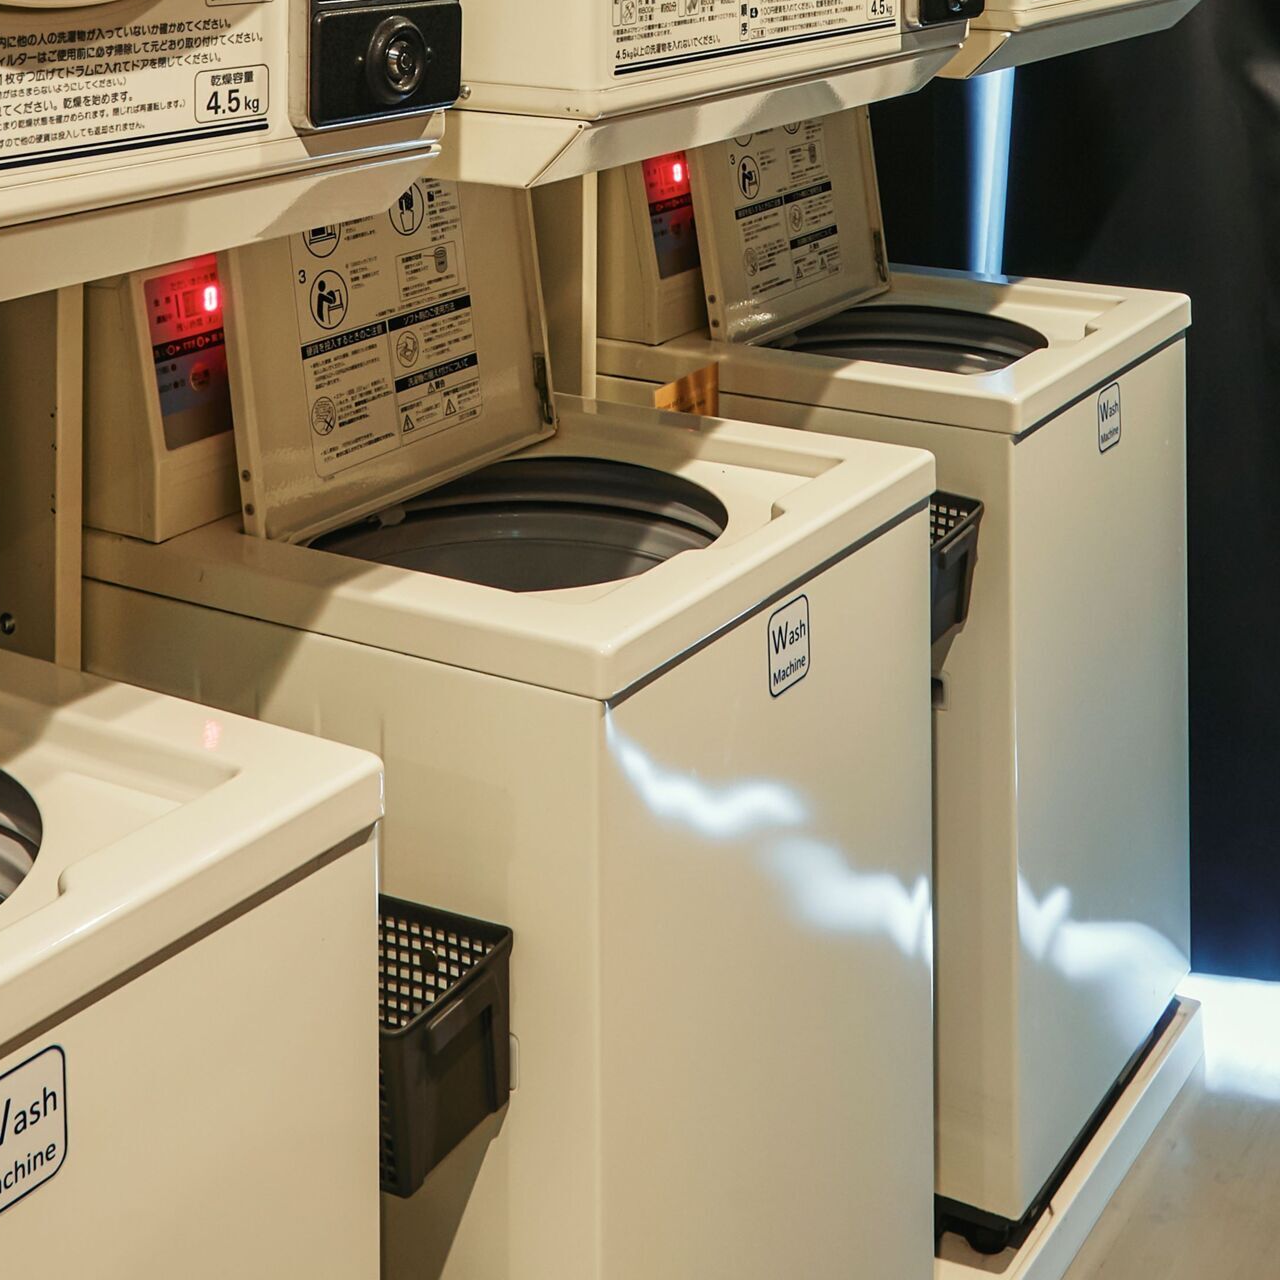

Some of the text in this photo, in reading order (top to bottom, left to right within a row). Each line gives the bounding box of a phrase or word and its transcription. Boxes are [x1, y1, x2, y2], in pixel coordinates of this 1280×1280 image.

[871, 0, 886, 16] 4.5
[211, 71, 254, 86] 乾燥容量
[207, 89, 259, 114] 4.5 kg
[730, 154, 736, 165] 3
[299, 270, 306, 284] 3
[204, 286, 217, 311] 0
[1100, 400, 1118, 422] Wash
[772, 619, 805, 654] Wash
[773, 656, 806, 686] Machine
